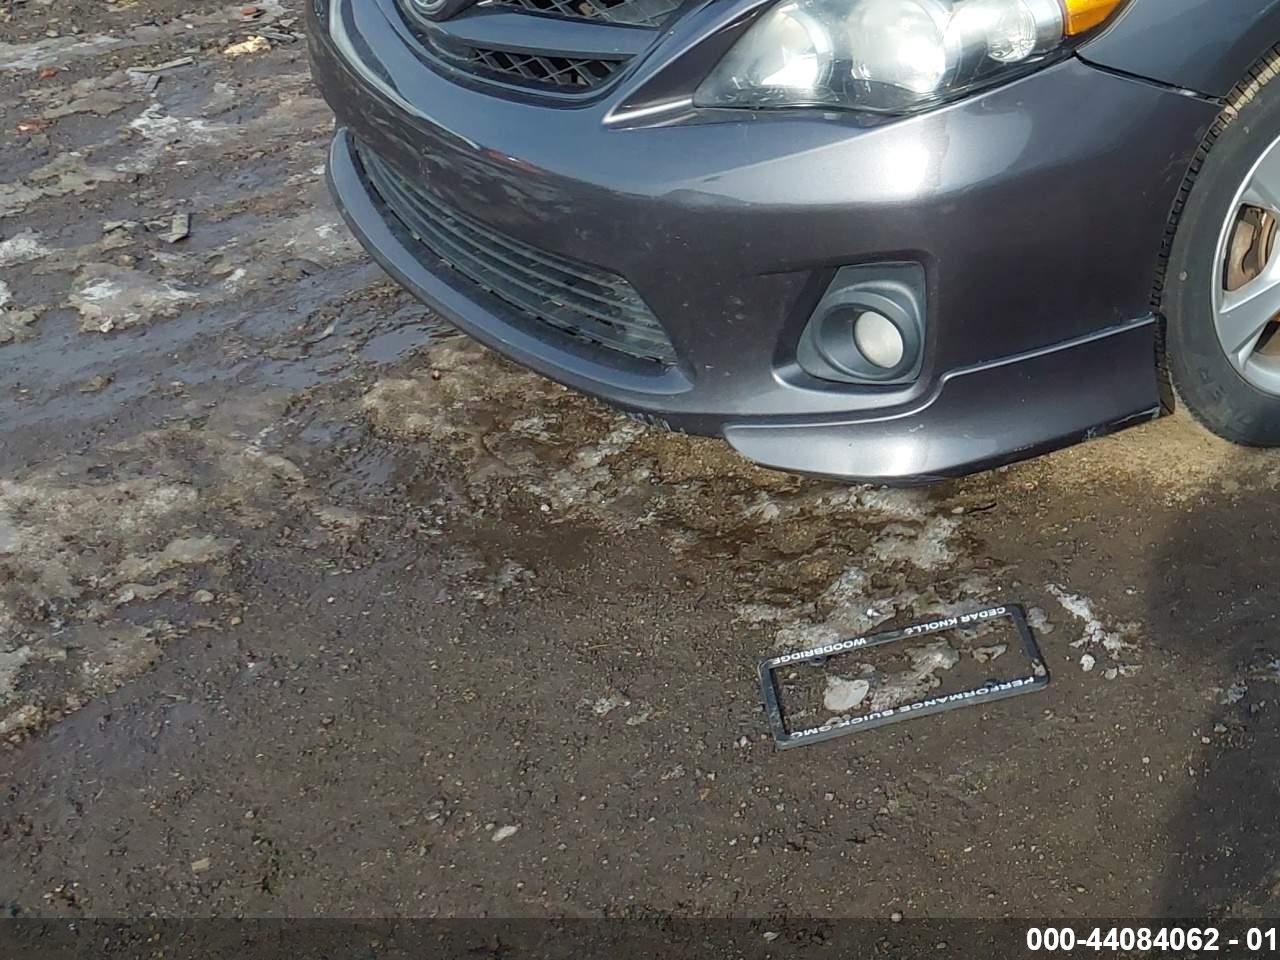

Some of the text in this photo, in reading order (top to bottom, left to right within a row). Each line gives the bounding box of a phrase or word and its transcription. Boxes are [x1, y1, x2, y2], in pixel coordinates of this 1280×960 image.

[903, 606, 1006, 636] CEDAR KNOLLS
[772, 637, 867, 665] WOODBRIDGE
[899, 676, 1035, 713] PERFORMANCE
[839, 709, 894, 728] BUICK
